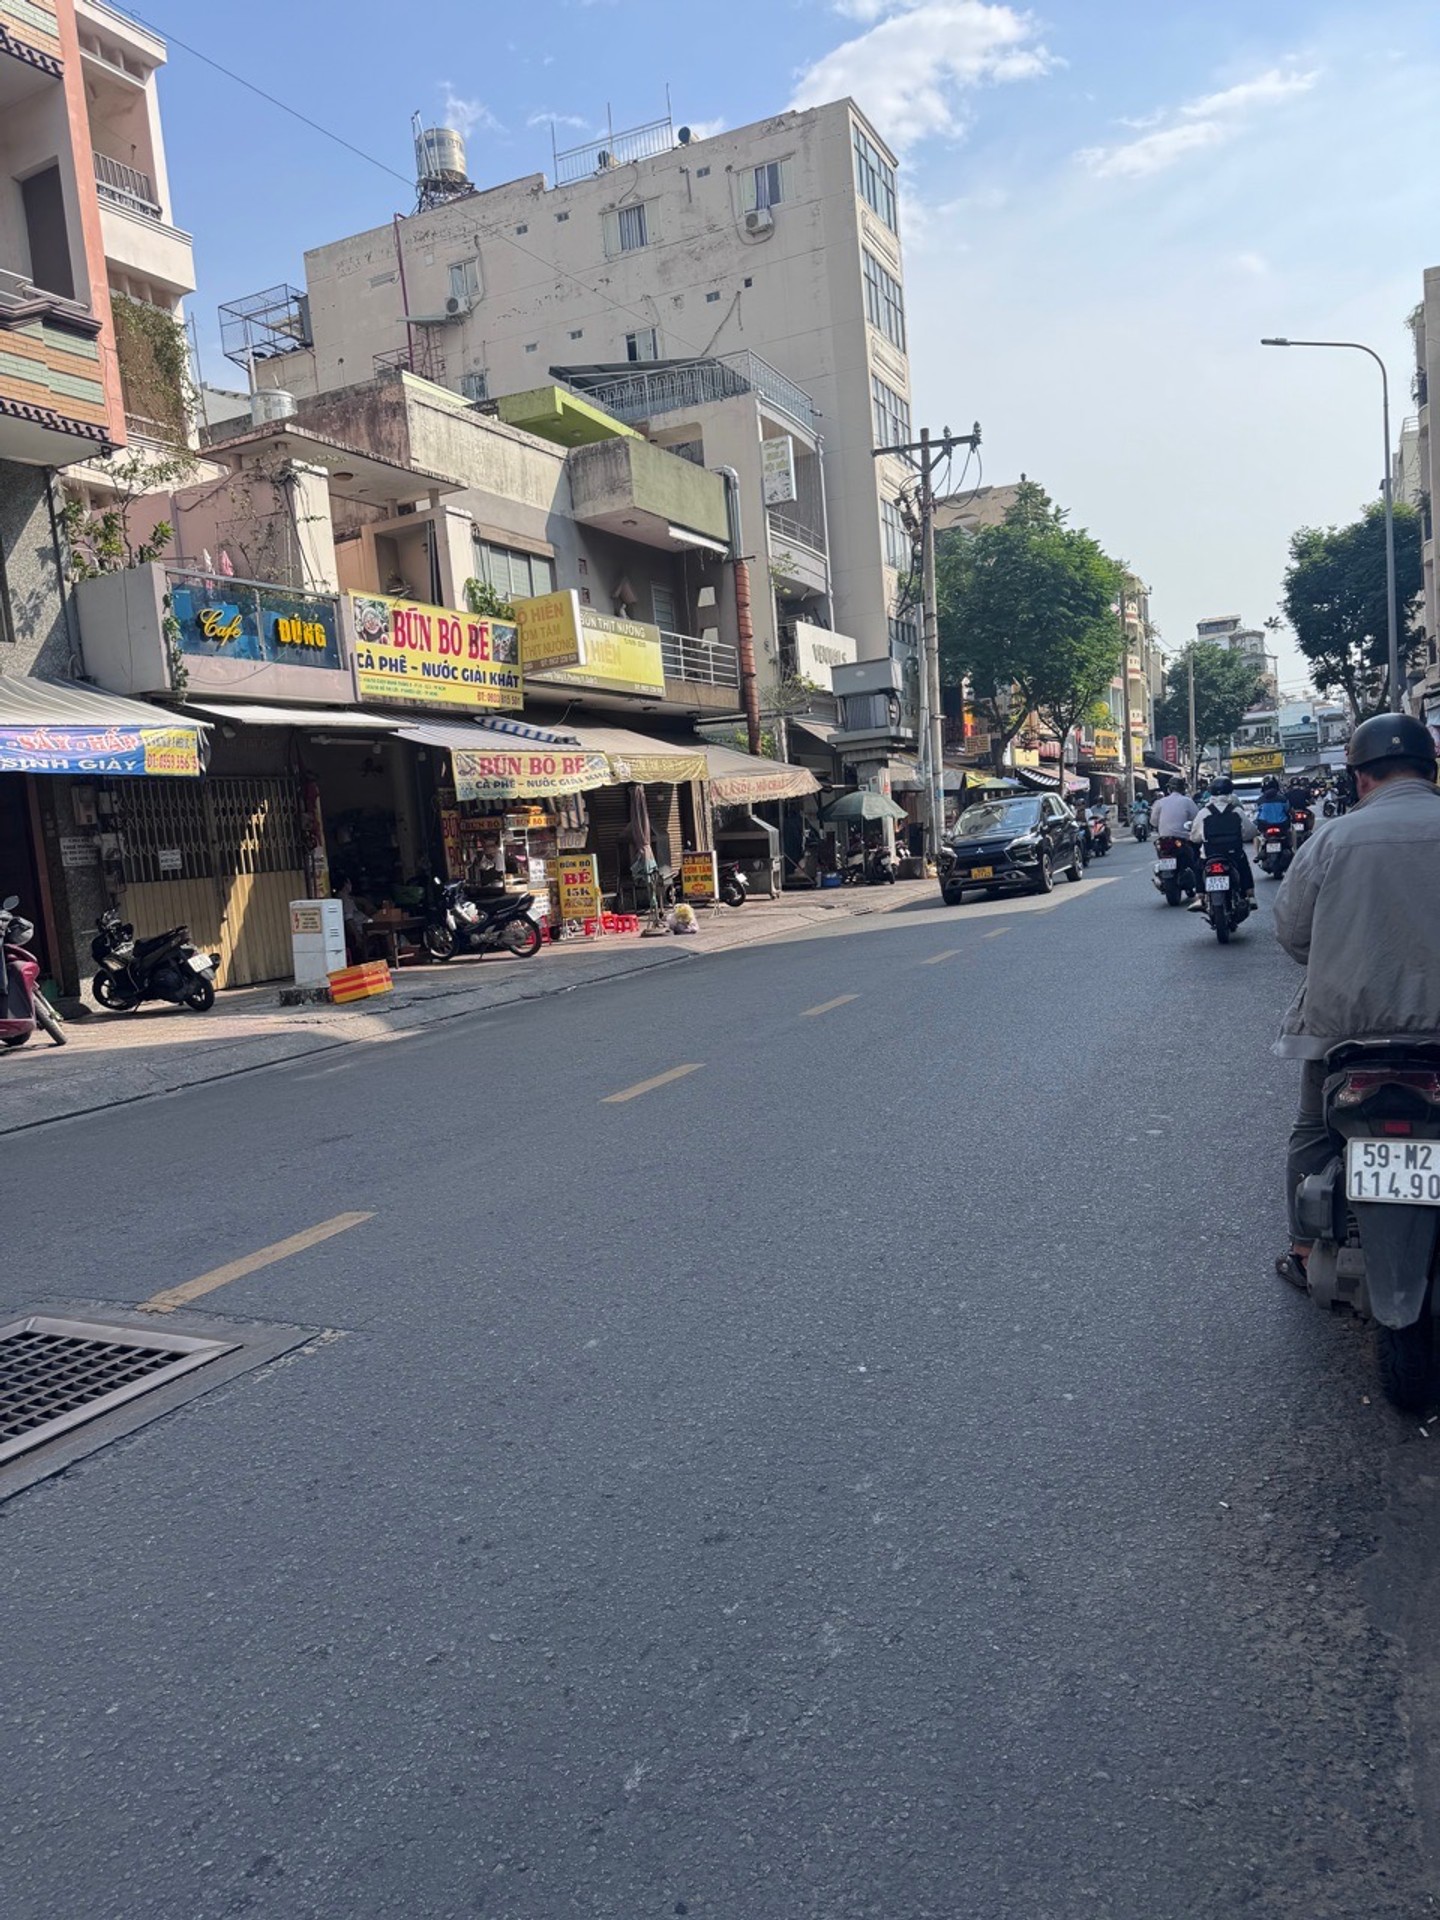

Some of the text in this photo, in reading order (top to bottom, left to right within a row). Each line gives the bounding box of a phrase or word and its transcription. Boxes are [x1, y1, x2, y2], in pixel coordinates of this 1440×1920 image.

[531, 599, 563, 623] HIỀN
[392, 607, 490, 661] BÚN BÒ BÉ
[357, 650, 375, 670] CÀ
[379, 655, 407, 674] PHÊ
[422, 659, 458, 681] NƯỚC
[461, 666, 486, 684] GIẢI
[489, 670, 520, 689] KHÁT
[78, 757, 137, 771] GIÀY
[1363, 1143, 1432, 1170] 59-M2
